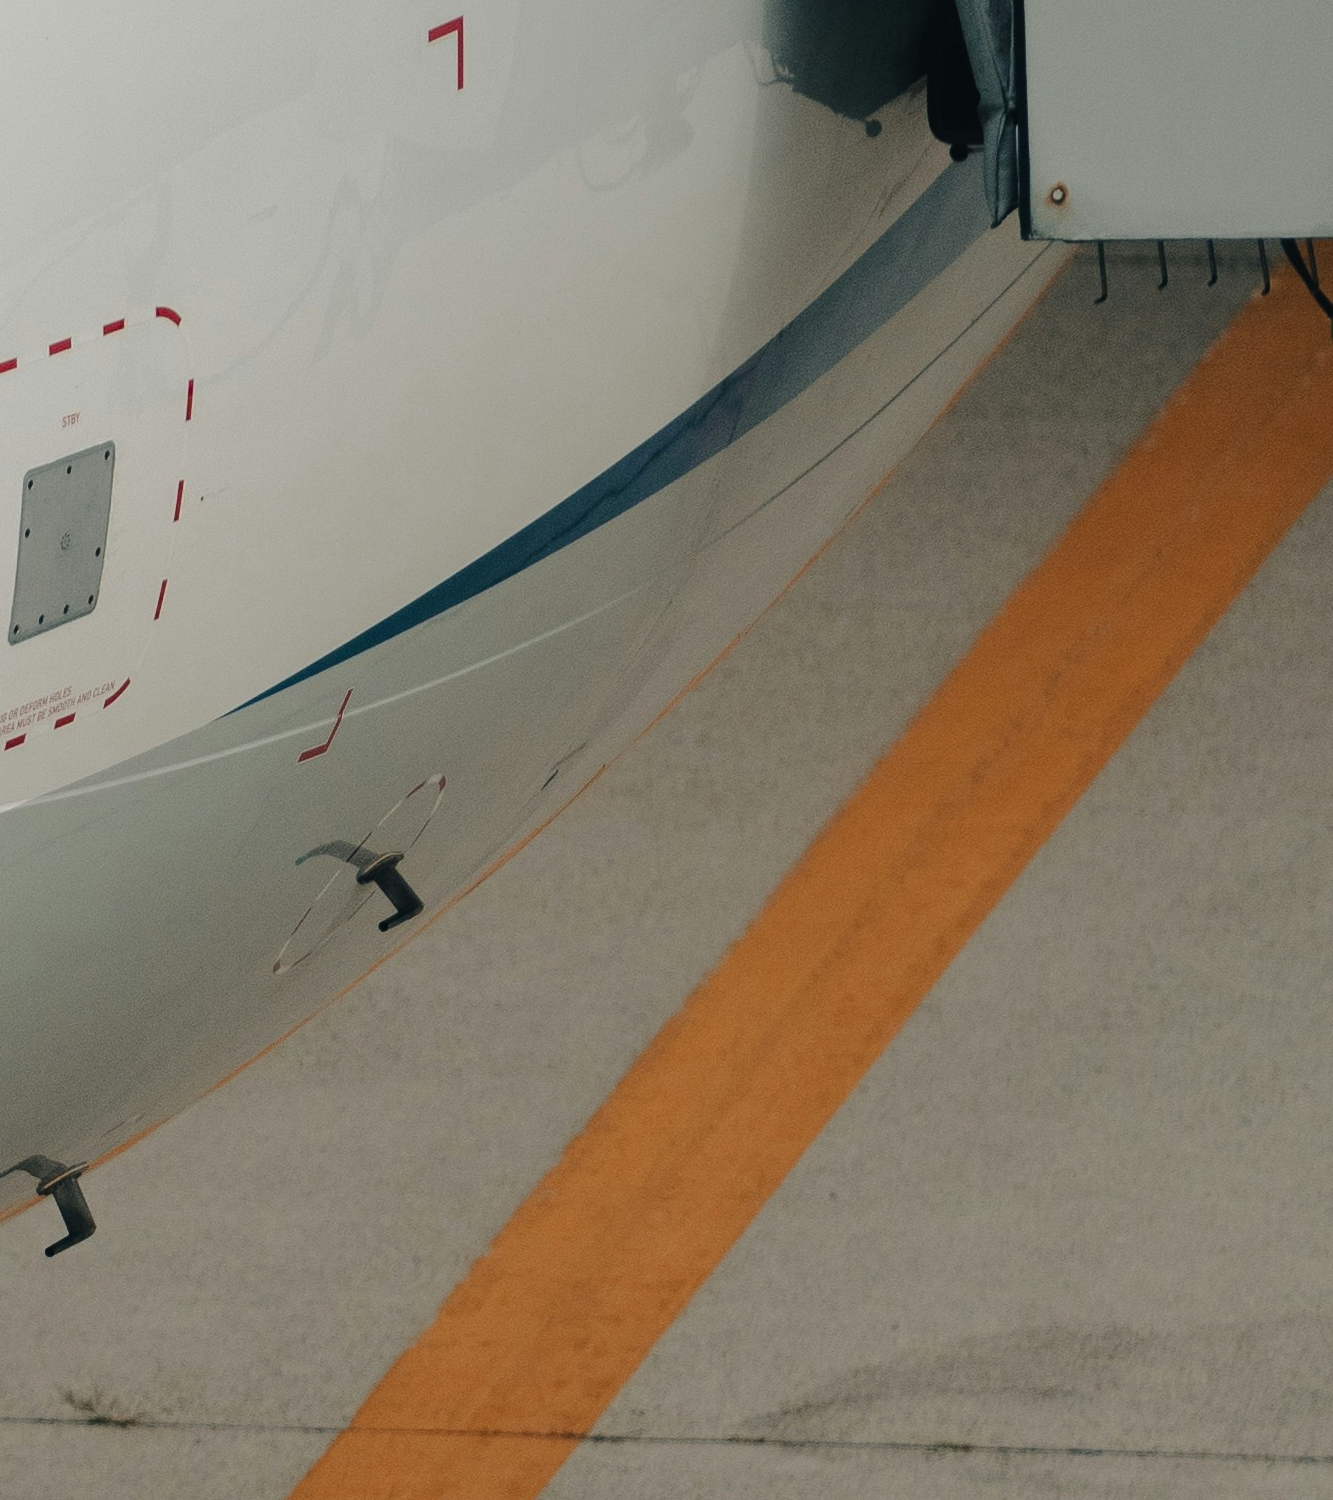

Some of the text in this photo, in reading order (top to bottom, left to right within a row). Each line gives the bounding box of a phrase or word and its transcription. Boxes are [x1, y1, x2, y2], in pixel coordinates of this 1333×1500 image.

[62, 411, 80, 428] STBY
[8, 708, 19, 720] OR
[20, 695, 49, 716] DEFORM
[49, 686, 72, 703] HOLES
[16, 714, 36, 729] MUST
[37, 708, 48, 721] BE
[48, 696, 76, 717] SMOOTH
[77, 690, 92, 703] AND
[93, 680, 115, 698] CLEAN
